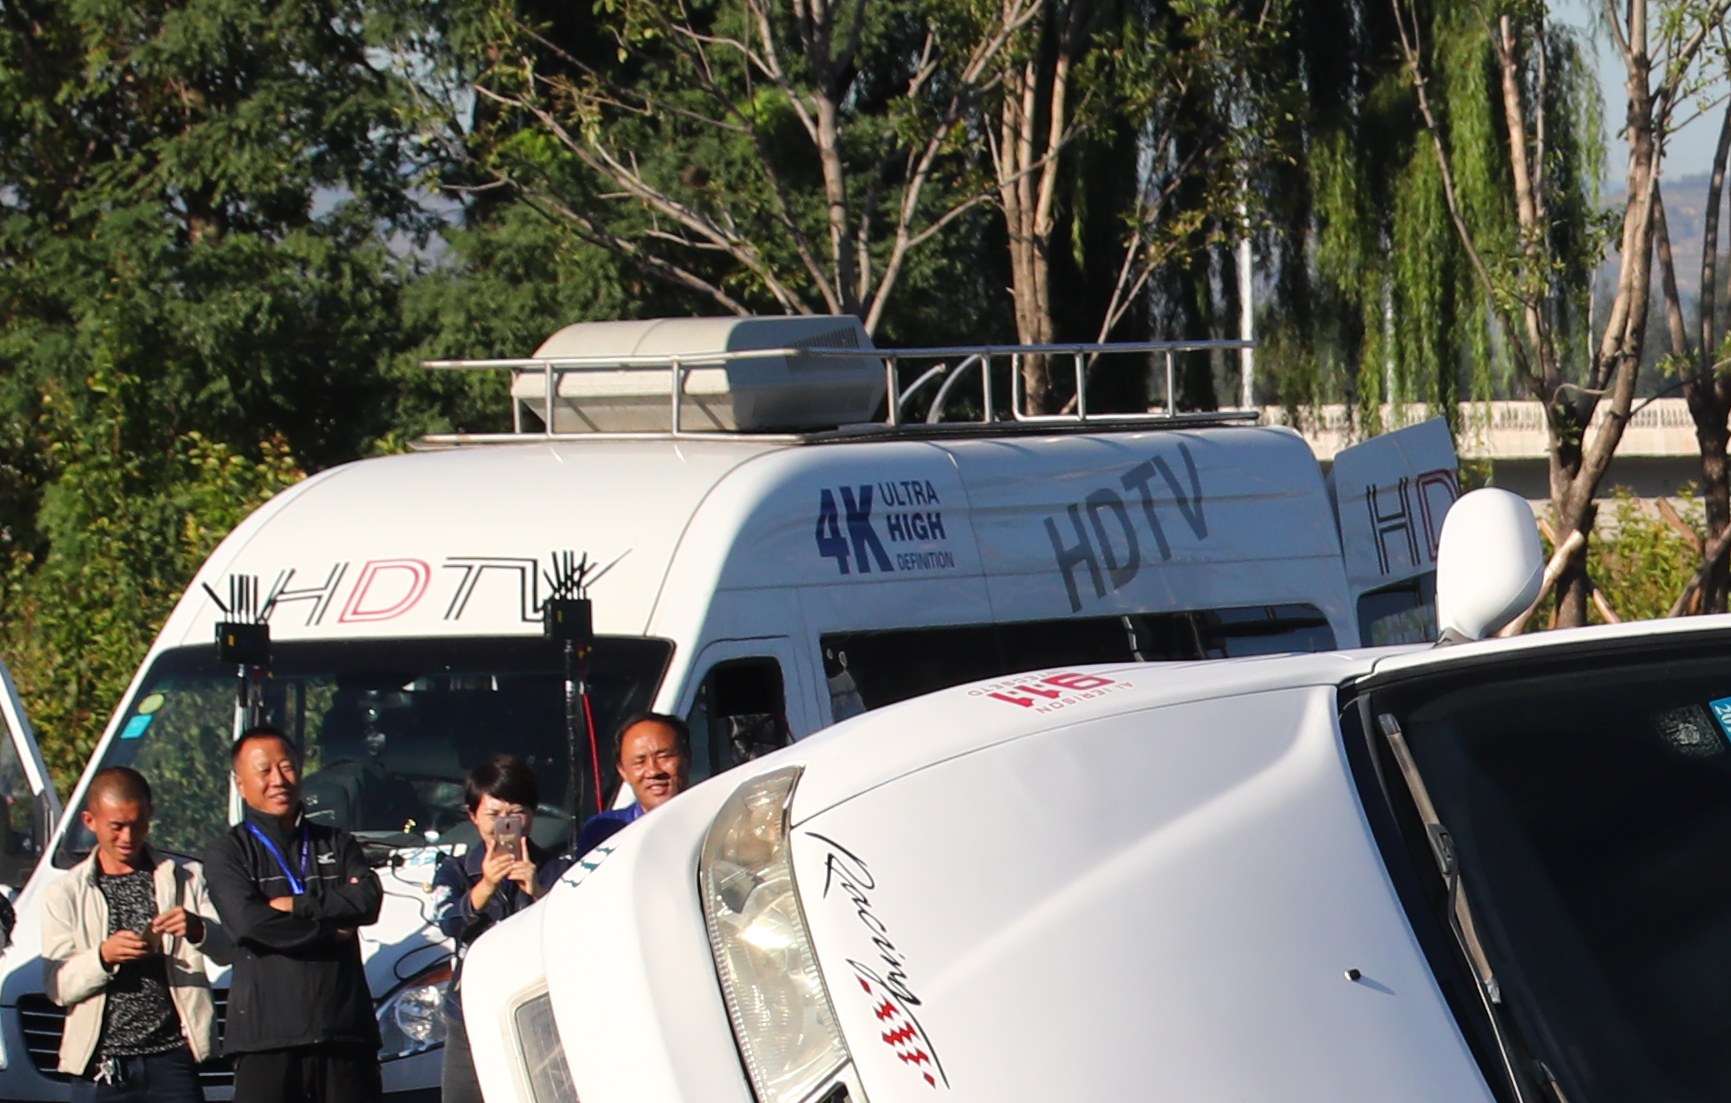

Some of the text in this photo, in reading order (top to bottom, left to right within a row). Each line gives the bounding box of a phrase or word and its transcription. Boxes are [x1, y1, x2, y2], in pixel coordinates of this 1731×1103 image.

[877, 480, 940, 507] ULTRA
[815, 484, 896, 576] 4K
[886, 511, 946, 542] HIGH
[1044, 442, 1210, 612] HDTV
[258, 546, 634, 627] HDTV
[896, 551, 955, 571] DEFINITION
